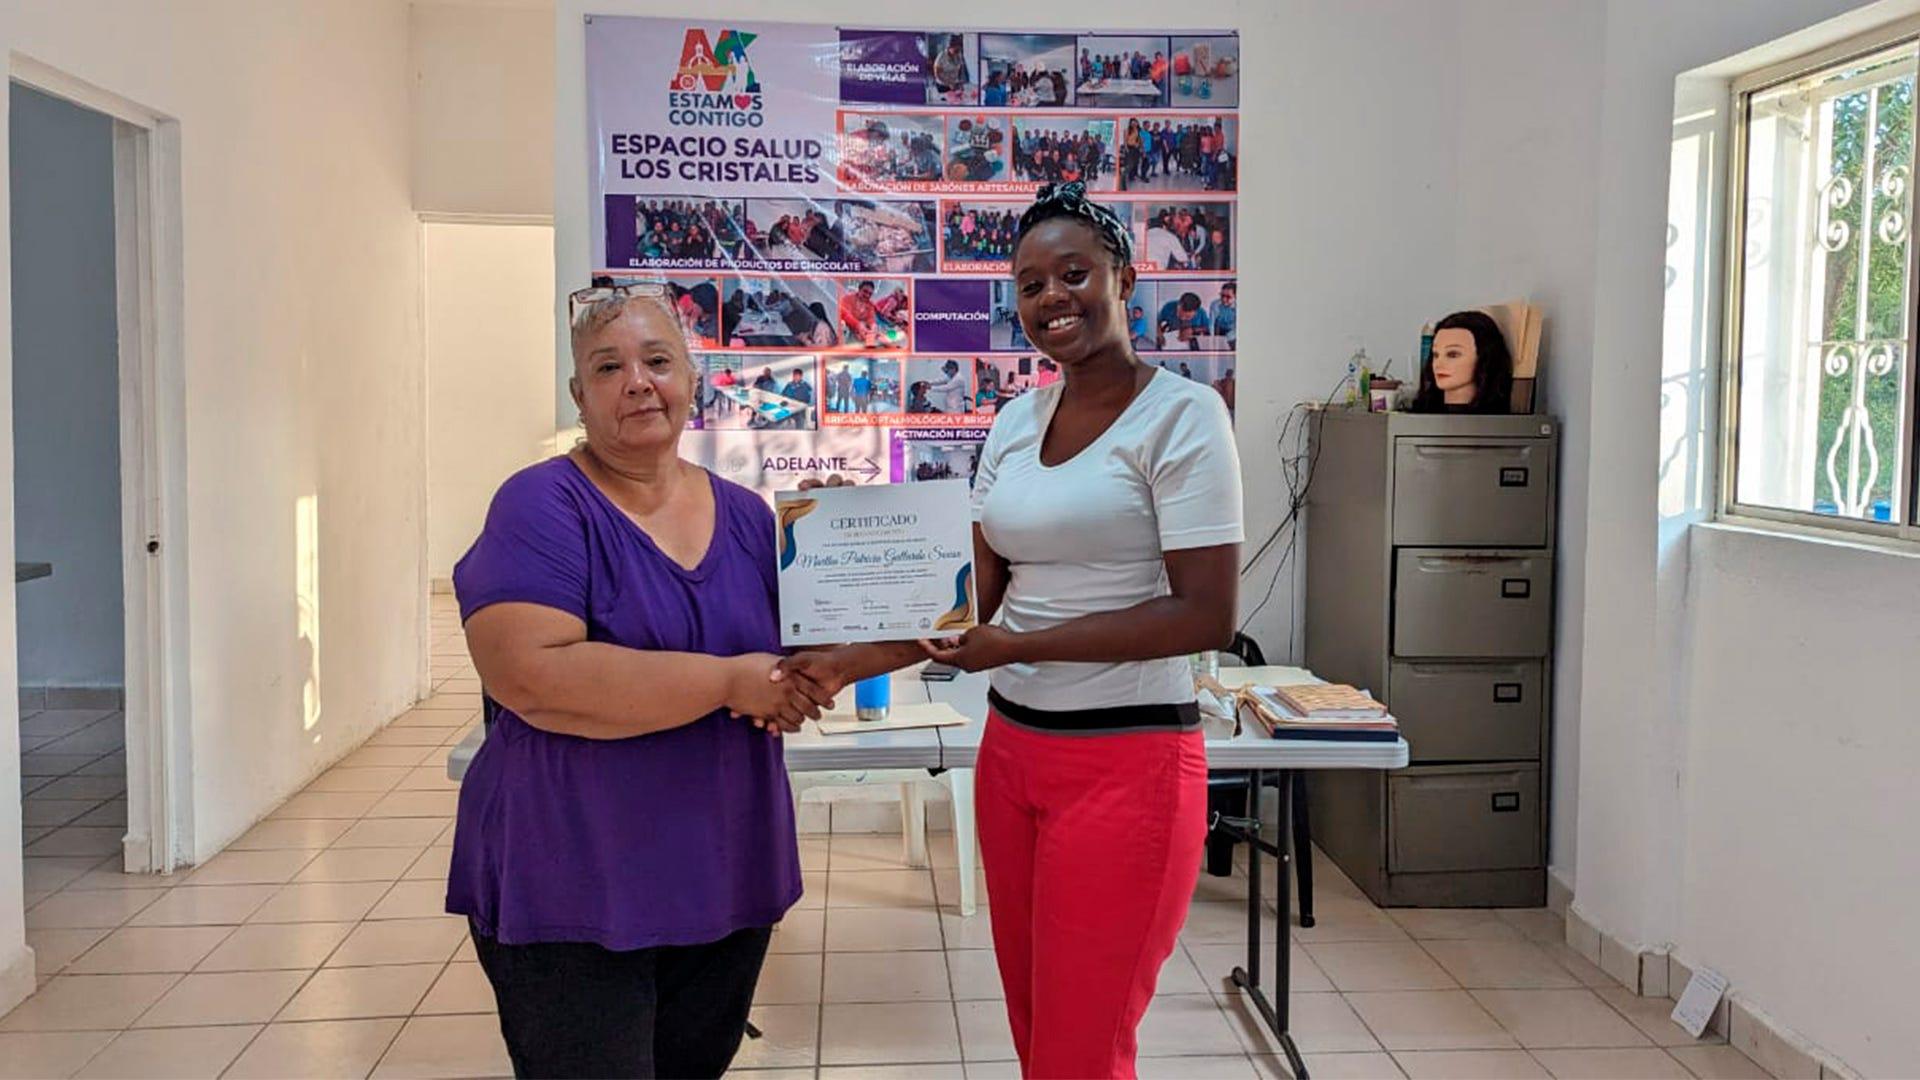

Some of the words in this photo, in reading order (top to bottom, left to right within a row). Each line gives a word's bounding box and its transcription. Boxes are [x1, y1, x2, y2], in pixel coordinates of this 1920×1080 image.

[669, 110, 764, 128] CONTIGO
[612, 134, 726, 158] ESPACIO
[734, 138, 822, 160] SALUD
[621, 159, 671, 179] LOS
[679, 161, 820, 183] CRISTALES
[914, 183, 928, 192] DE
[629, 257, 702, 267] ELABORACIÓN
[705, 259, 718, 268] DE
[720, 260, 783, 270] PRODUCTOS
[785, 261, 799, 270] DE
[801, 261, 861, 271] CHOCOLATE
[915, 310, 989, 320] COMPUTACIÓN
[824, 414, 868, 424] BRIGADA
[955, 415, 962, 424] Y
[894, 429, 954, 438] ACTIVACIÓN
[762, 457, 847, 471] ADELANTE
[830, 514, 917, 530] CERTIFICADO
